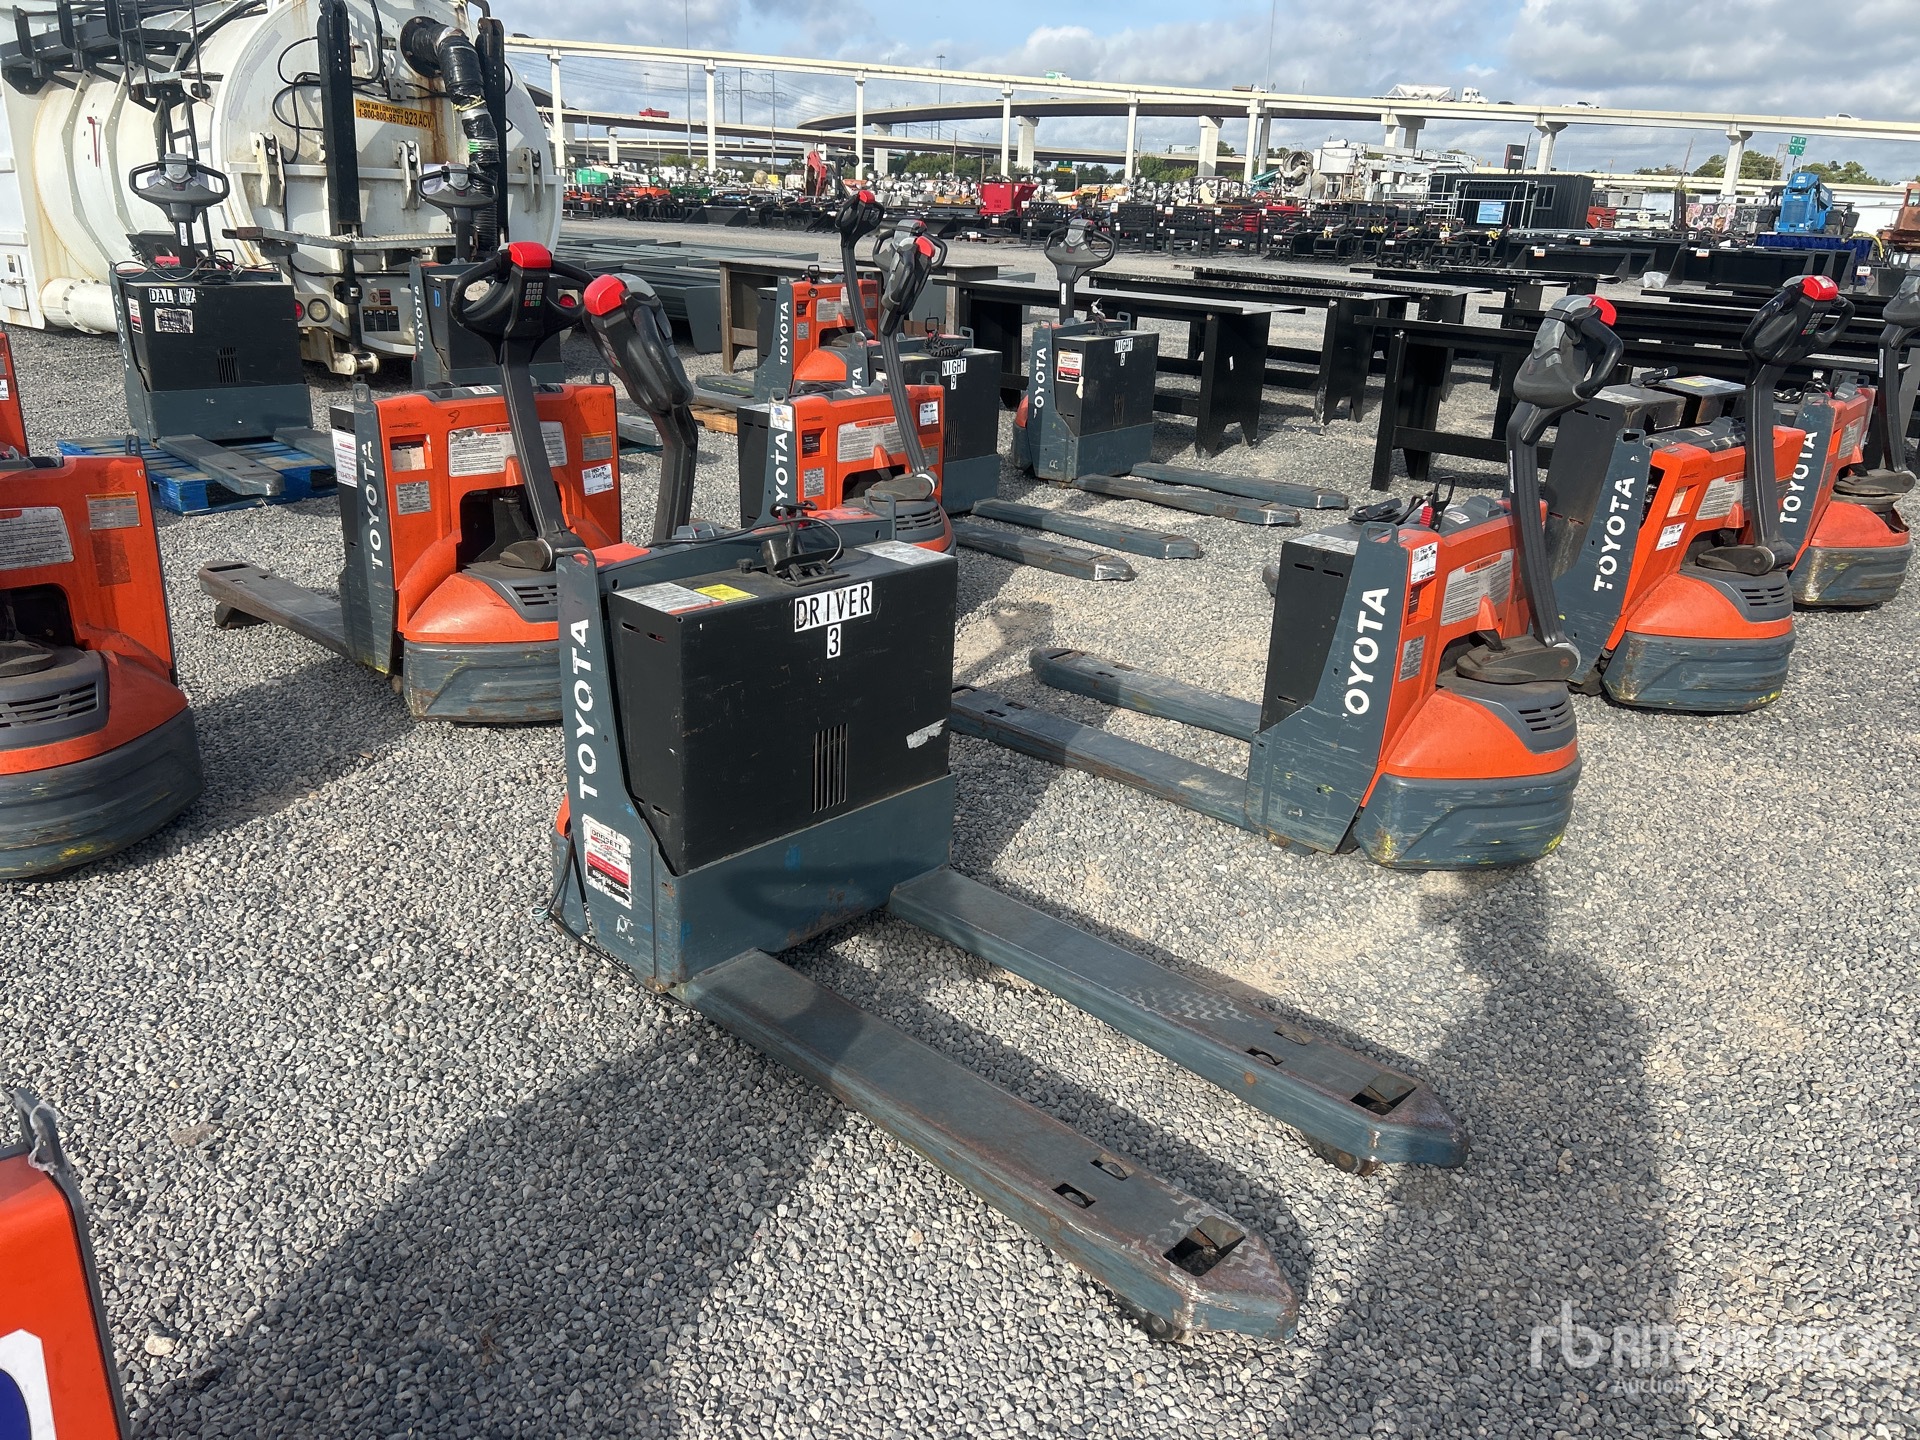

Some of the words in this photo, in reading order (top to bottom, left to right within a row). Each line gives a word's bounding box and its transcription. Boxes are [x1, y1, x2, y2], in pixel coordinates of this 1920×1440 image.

[358, 108, 404, 124] 1-800-800-9577
[404, 110, 418, 126] 923
[418, 114, 432, 128] ACV
[382, 106, 404, 115] DRIVING?
[149, 288, 173, 302] DAL
[115, 293, 130, 371] TOYOTA
[415, 286, 424, 352] TOYOTA
[780, 301, 789, 365] TOYOTA
[942, 359, 966, 375] NIGHT
[1115, 339, 1133, 352] NIGHT
[952, 375, 957, 389] 9
[361, 440, 384, 570] TOYOTA
[1593, 477, 1635, 592] TOYOTA
[795, 585, 870, 630] DRIVER
[829, 627, 840, 656] 3
[1343, 588, 1390, 717] OYOTA
[570, 619, 598, 799] TOYOTA
